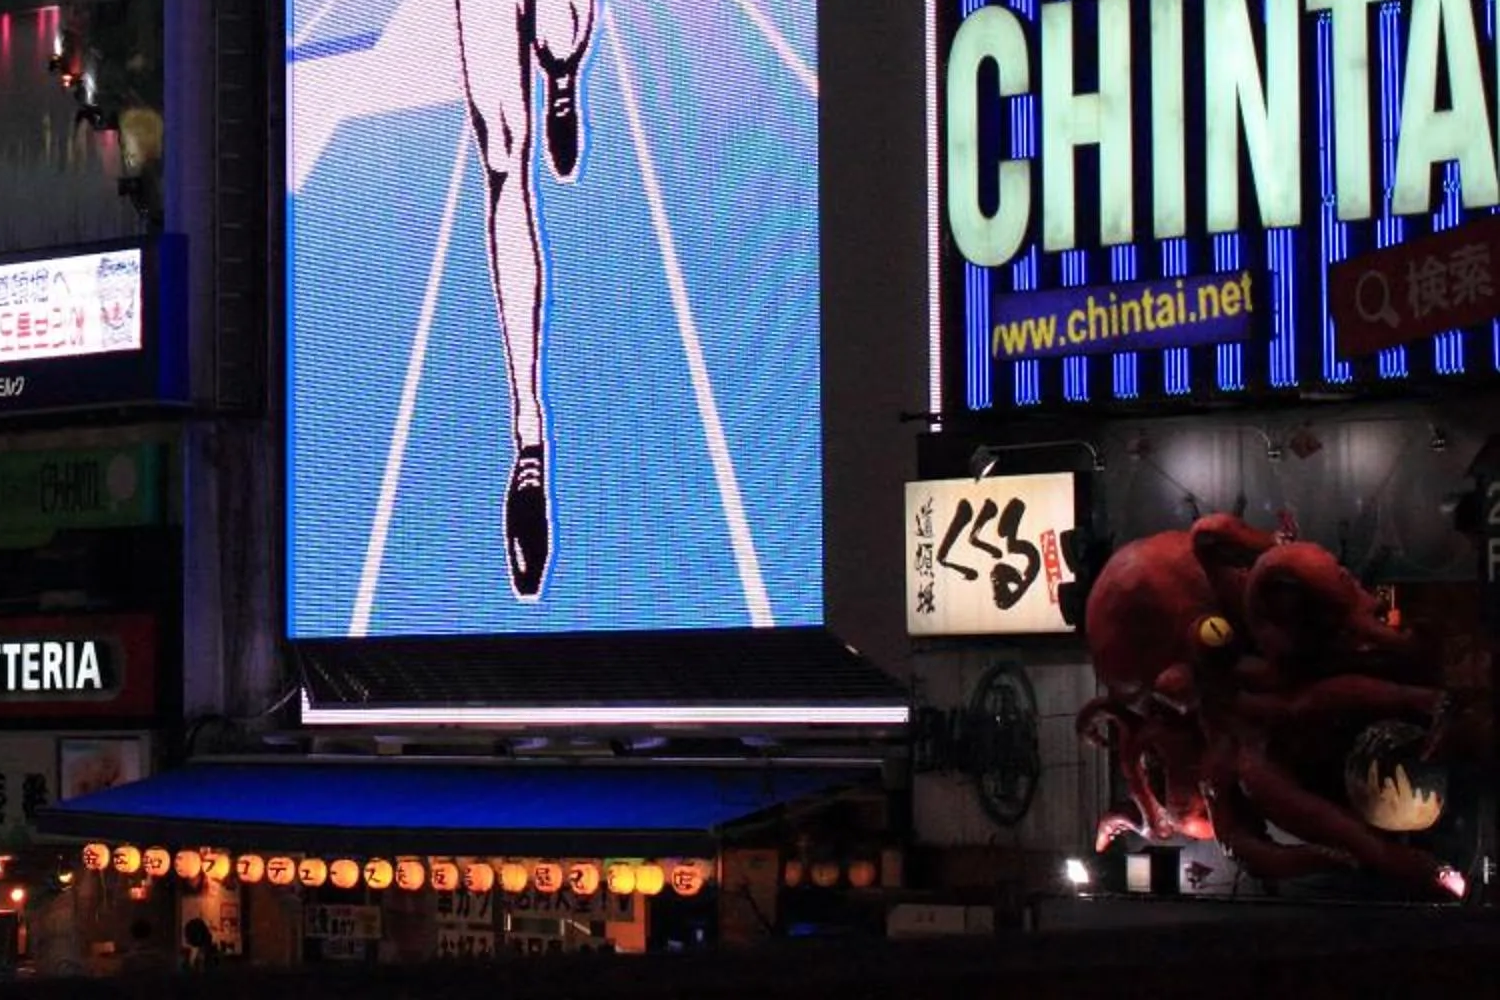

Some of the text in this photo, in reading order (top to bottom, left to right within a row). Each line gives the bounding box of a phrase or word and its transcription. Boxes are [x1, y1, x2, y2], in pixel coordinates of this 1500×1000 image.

[1406, 243, 1497, 319] 検索
[937, 497, 1041, 611] くくる
